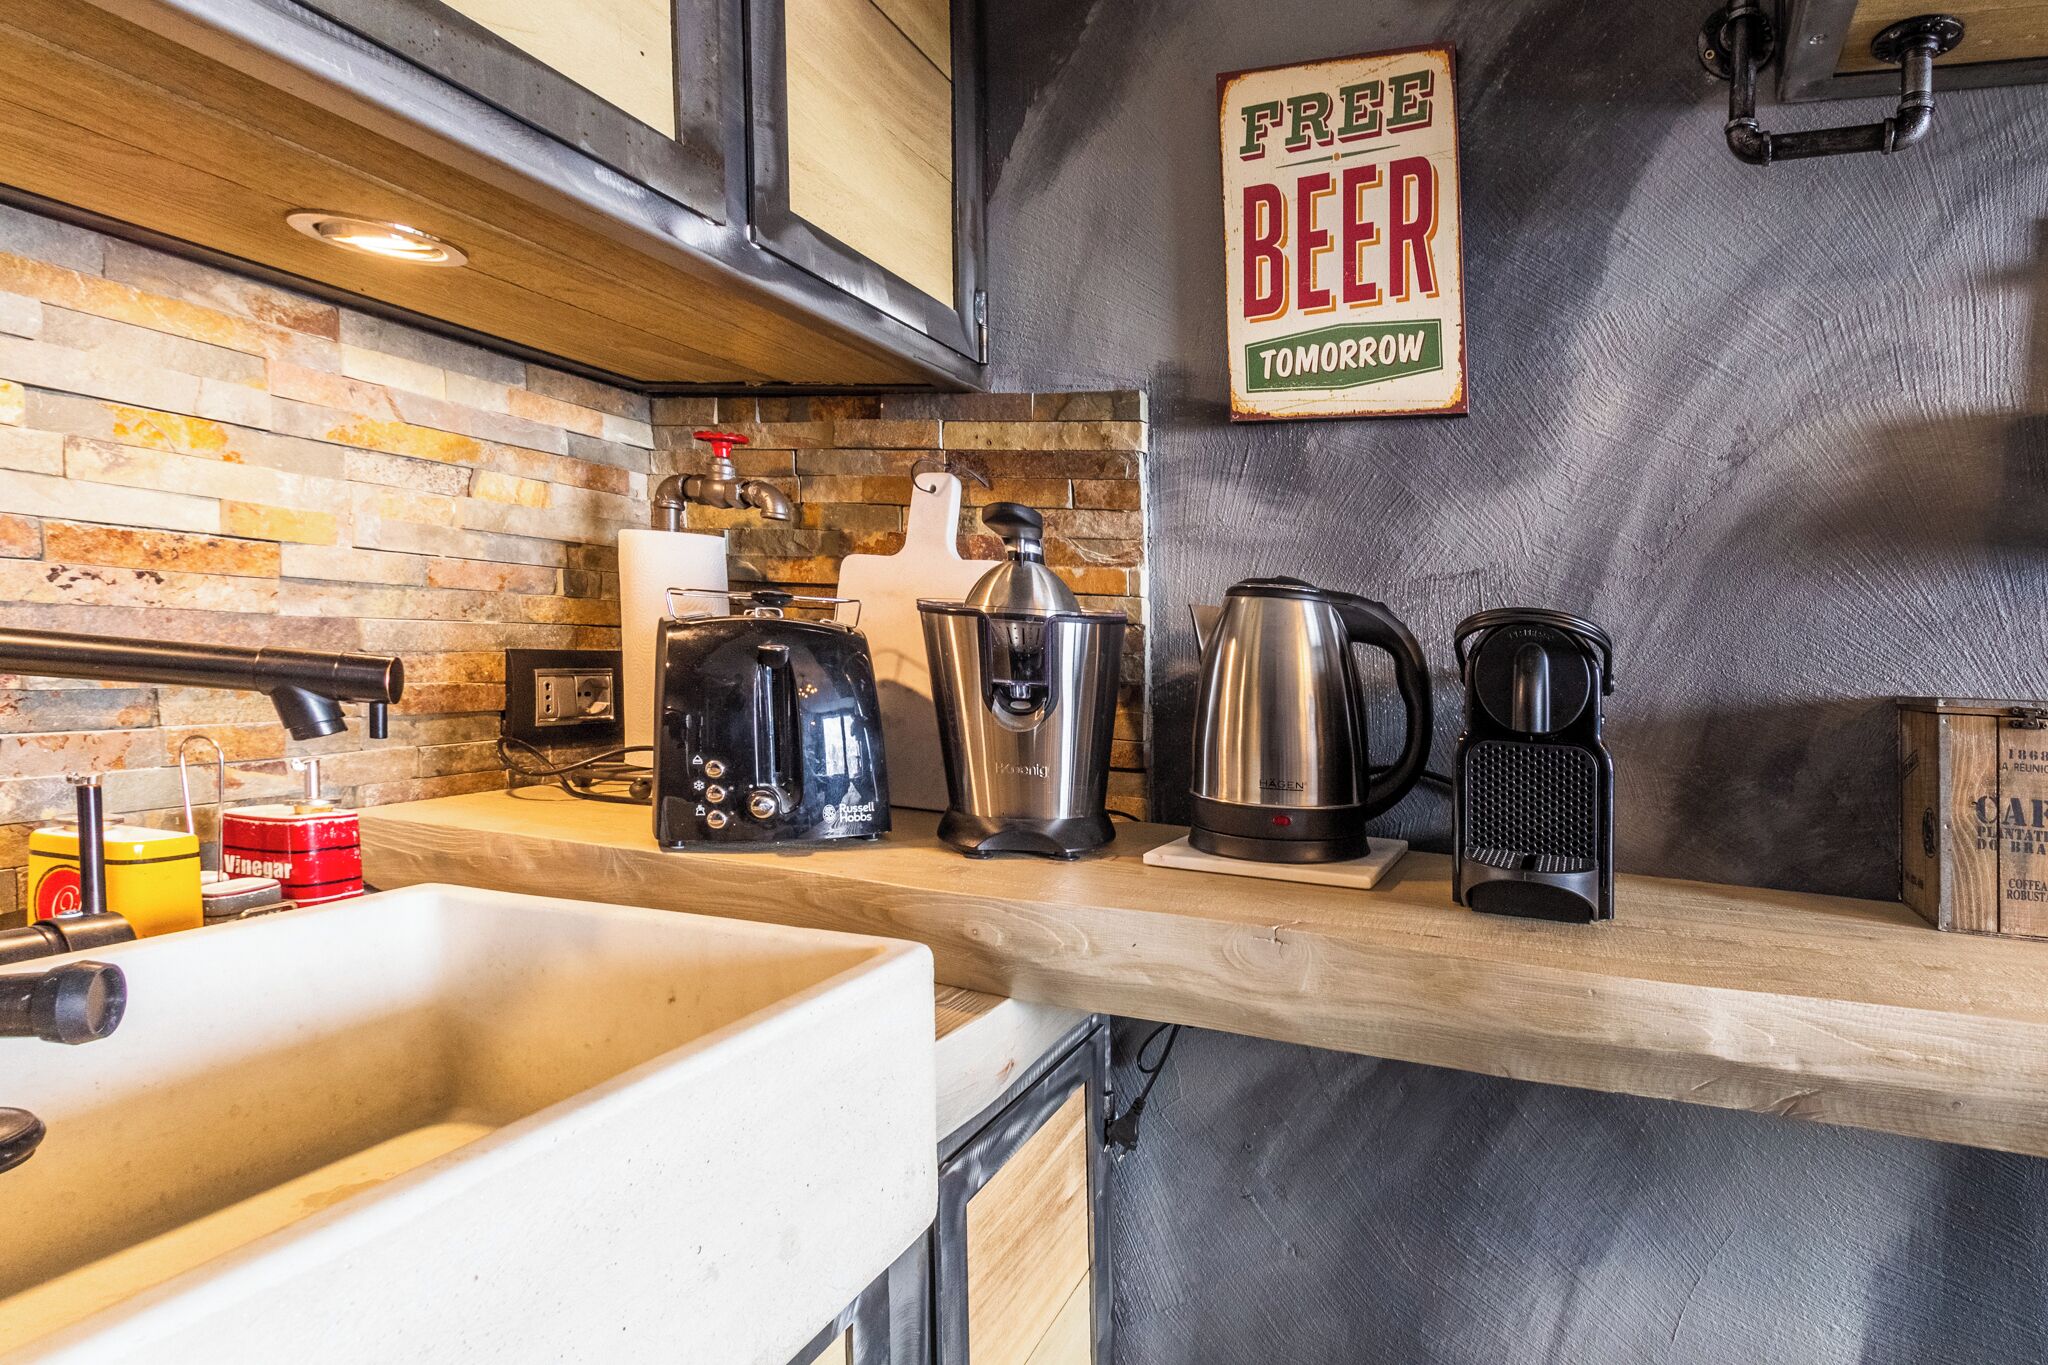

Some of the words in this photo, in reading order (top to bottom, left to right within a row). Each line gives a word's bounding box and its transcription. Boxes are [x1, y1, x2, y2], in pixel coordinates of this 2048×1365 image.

[1239, 69, 1435, 161] FREE
[1243, 155, 1440, 324] BEER
[1260, 330, 1425, 380] TOMORROW
[1259, 777, 1304, 789] HÄGEN
[839, 801, 875, 813] Russell
[839, 812, 872, 822] Hobbs
[224, 854, 293, 879] Vinegar
[2009, 878, 2048, 891] COFFEA
[2007, 889, 2048, 902] ROBUST
